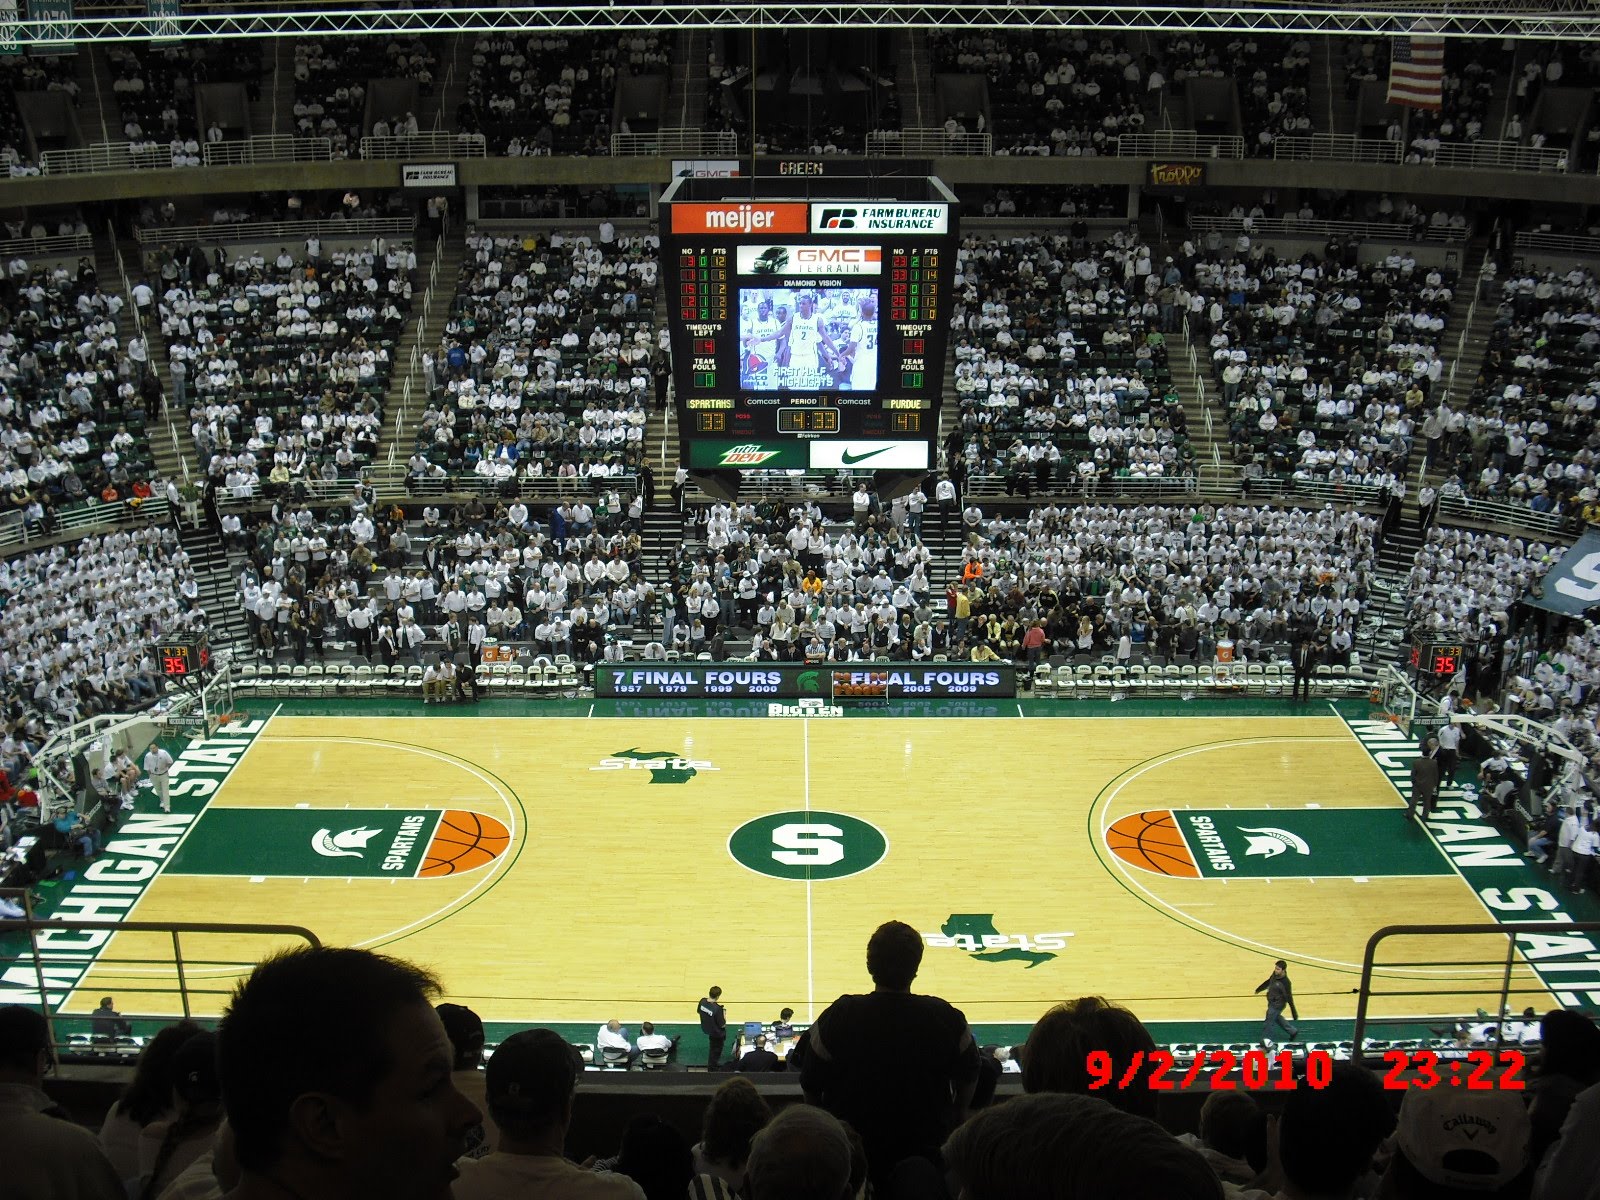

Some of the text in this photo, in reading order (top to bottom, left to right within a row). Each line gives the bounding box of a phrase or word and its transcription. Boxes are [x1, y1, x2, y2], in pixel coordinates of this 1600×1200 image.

[695, 170, 729, 178] GMC
[779, 162, 823, 175] GREEN
[705, 204, 775, 233] meijer
[862, 208, 942, 218] FARM BUREAU
[868, 219, 934, 229] INSURANCE
[688, 256, 694, 266] 3
[716, 256, 724, 266] 12
[798, 250, 860, 262] GMC
[799, 264, 860, 272] TERRAIN
[928, 270, 936, 280] 14
[801, 332, 806, 340] 2
[705, 341, 713, 350] 4
[914, 341, 922, 350] 4
[777, 376, 834, 387] HIGHLIGHTS
[690, 399, 731, 409] SPARTANS
[890, 399, 922, 409] PURDUE
[703, 414, 724, 430] 33
[793, 412, 834, 428] 4:33
[897, 413, 919, 431] 47
[164, 657, 185, 673] 35
[1434, 657, 1455, 672] 35
[613, 672, 781, 684] 7 FINAL FOURS
[924, 672, 1000, 685] FOURS
[588, 758, 720, 770] State
[381, 816, 426, 870] SPARTANS
[771, 824, 844, 865] S
[1189, 816, 1236, 870] SPARTANS
[0, 720, 265, 1004] MICHIGAN STATE
[1443, 1114, 1497, 1134] Callaway
